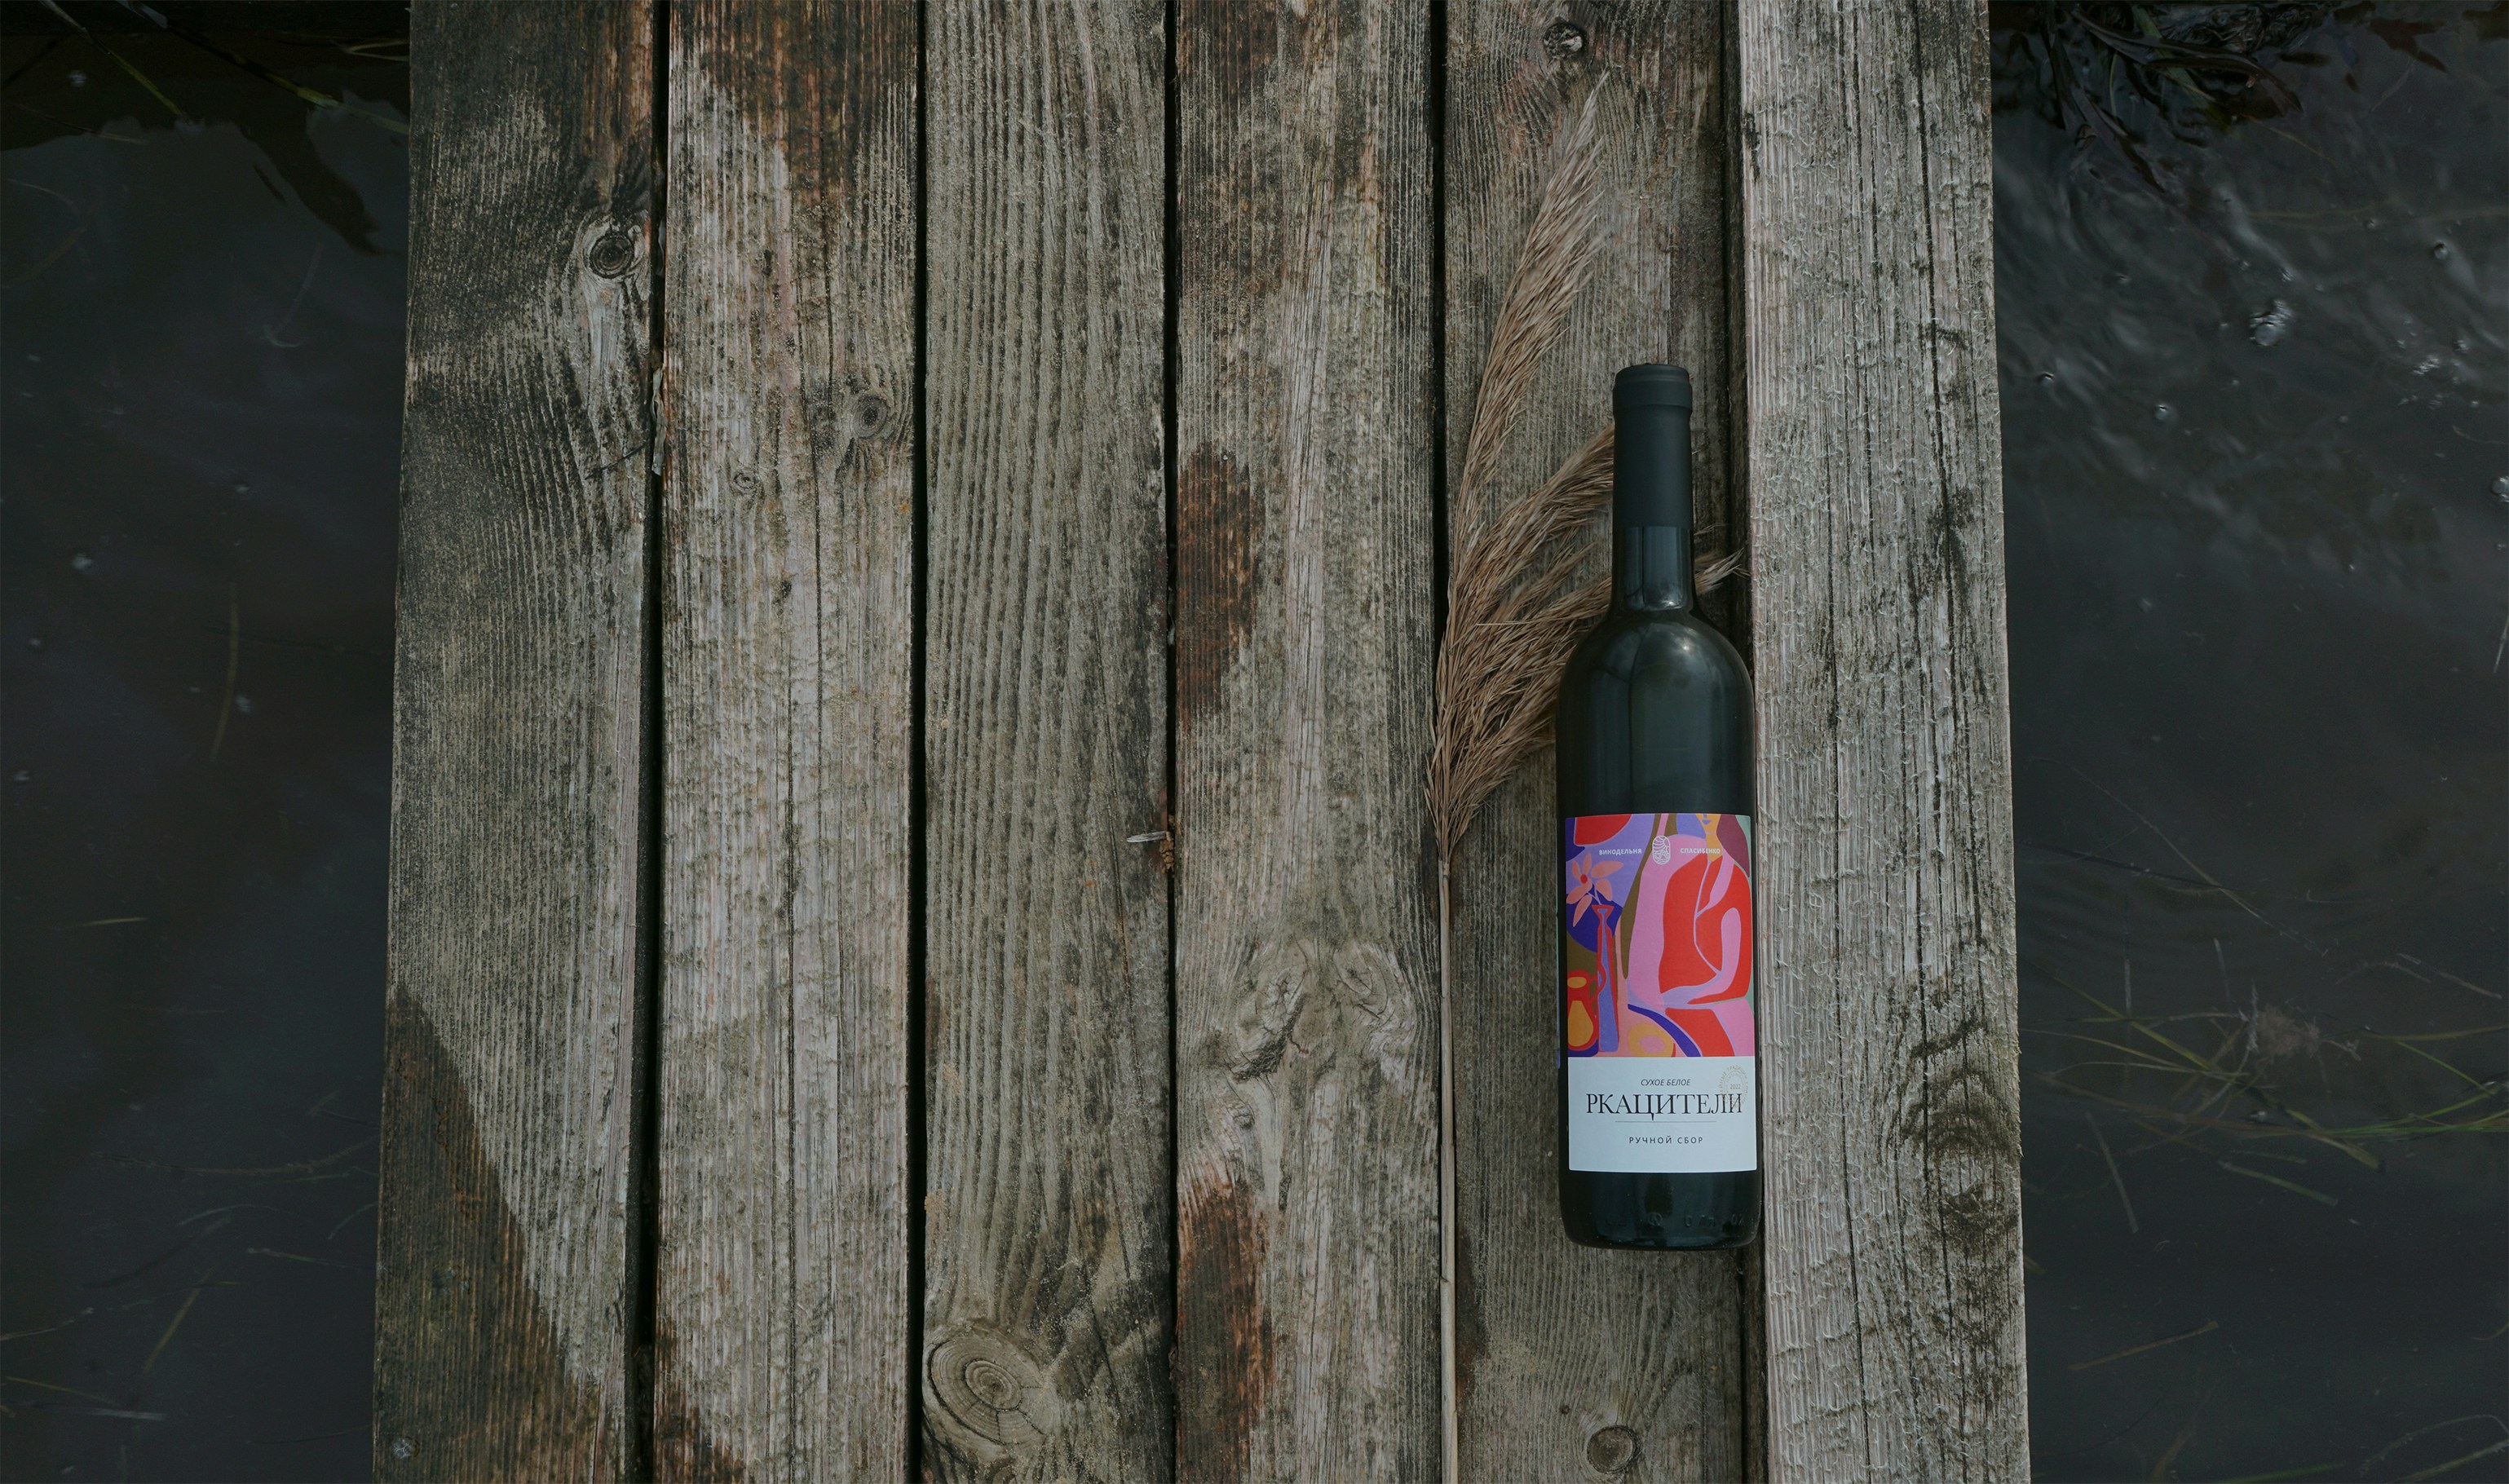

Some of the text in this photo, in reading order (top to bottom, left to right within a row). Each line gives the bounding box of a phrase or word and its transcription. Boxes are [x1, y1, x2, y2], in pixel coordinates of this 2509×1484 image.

[1599, 848, 1642, 856] ВИНОДЕЛЬНЯ
[1586, 1093, 1743, 1121] РКАЦИТЕЛИ
[1628, 1135, 1672, 1144] РУЧНОЙ
